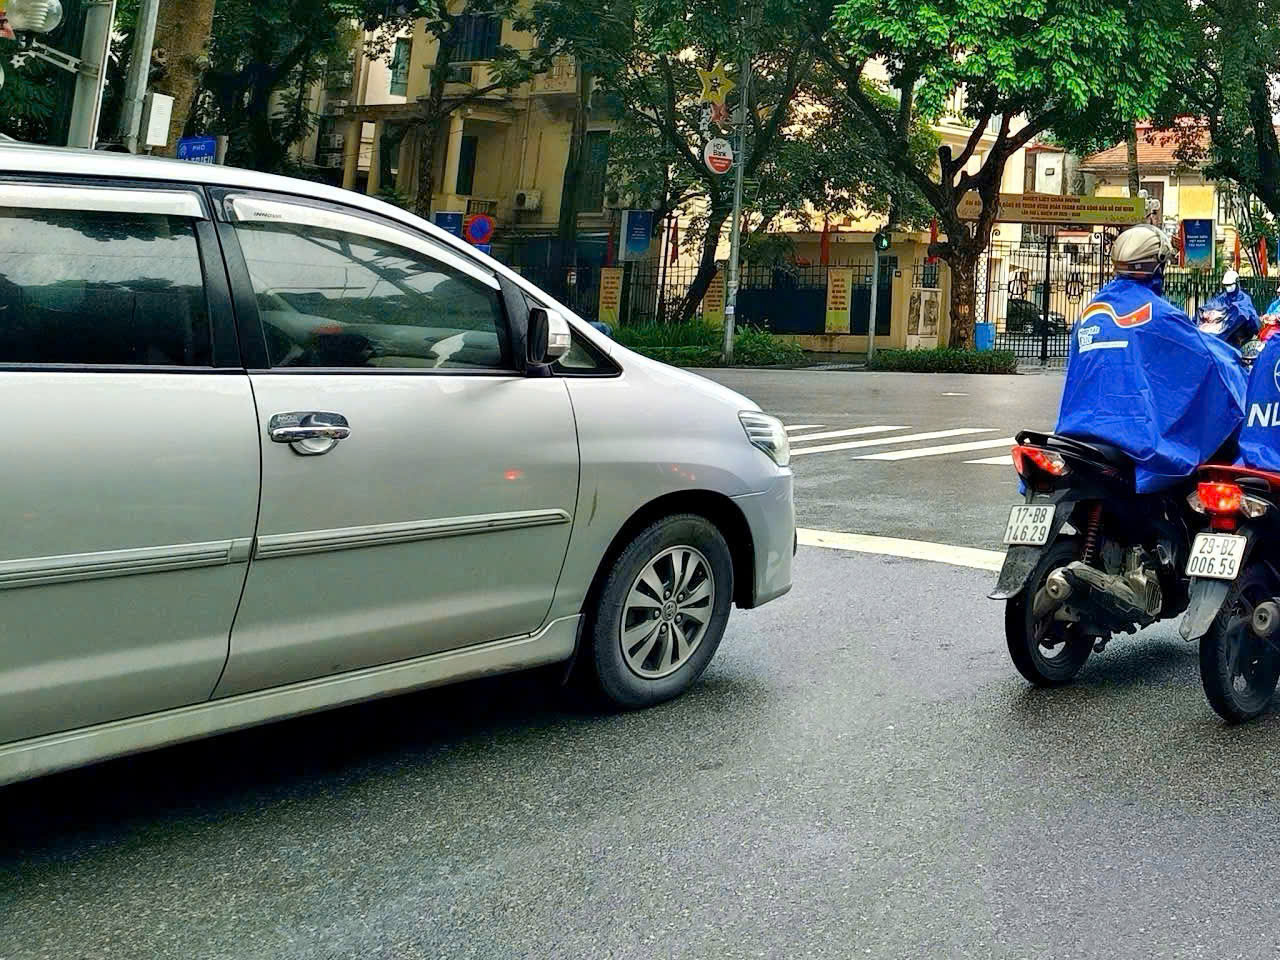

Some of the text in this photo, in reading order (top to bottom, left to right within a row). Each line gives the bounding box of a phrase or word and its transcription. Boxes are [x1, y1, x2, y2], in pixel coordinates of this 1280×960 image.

[1008, 525, 1047, 542] 146.29
[1199, 537, 1237, 556] 29-B2
[1190, 556, 1236, 575] 006.59
